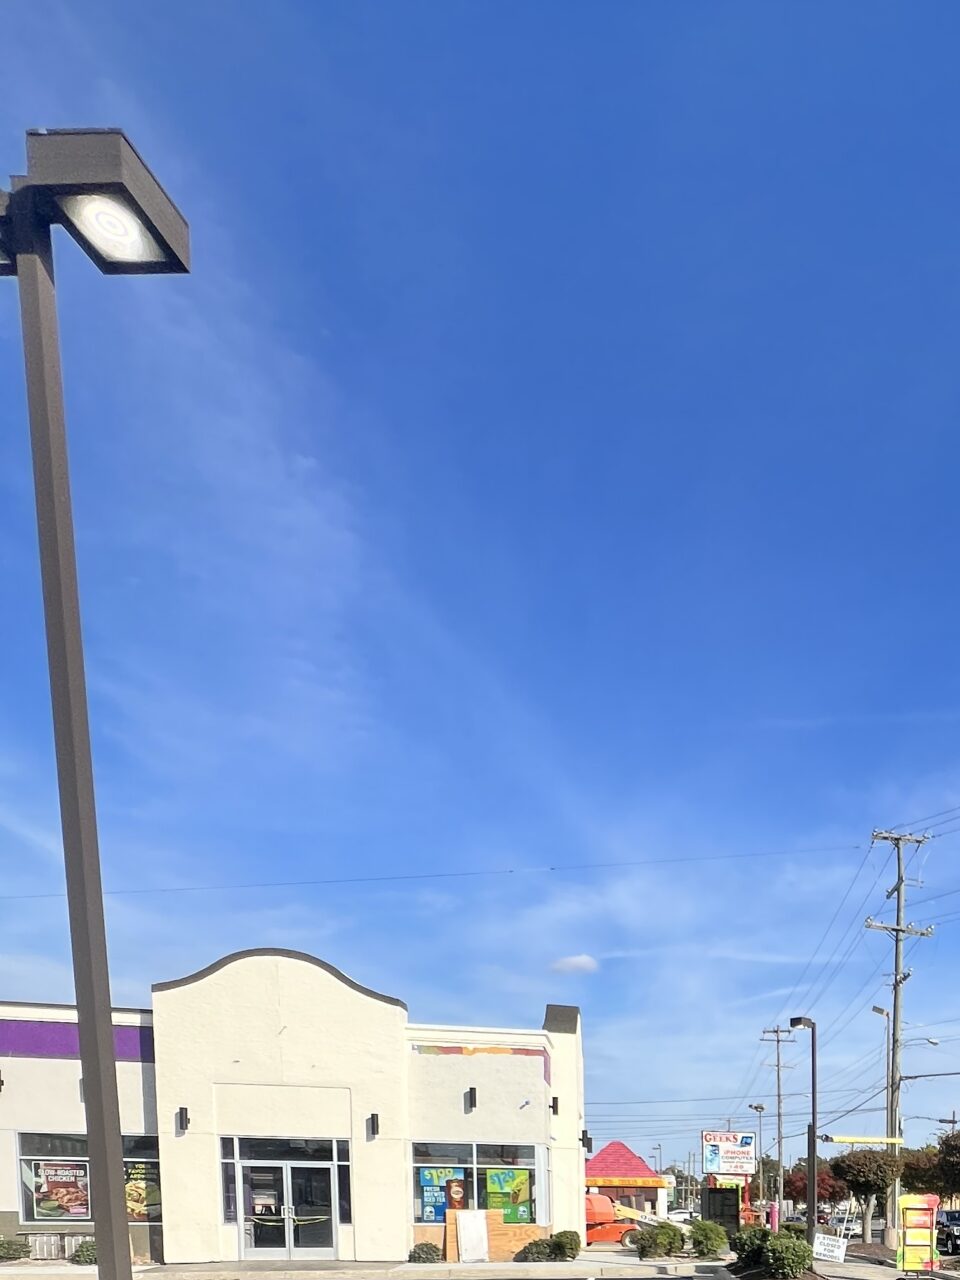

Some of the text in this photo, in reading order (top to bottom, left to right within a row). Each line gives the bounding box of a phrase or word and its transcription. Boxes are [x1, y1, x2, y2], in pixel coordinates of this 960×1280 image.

[704, 1133, 738, 1143] GEEKS
[38, 1169, 84, 1177] SLOW-ROASTED
[819, 1241, 841, 1249] CLOSED
[815, 1252, 840, 1260] REMODEL
